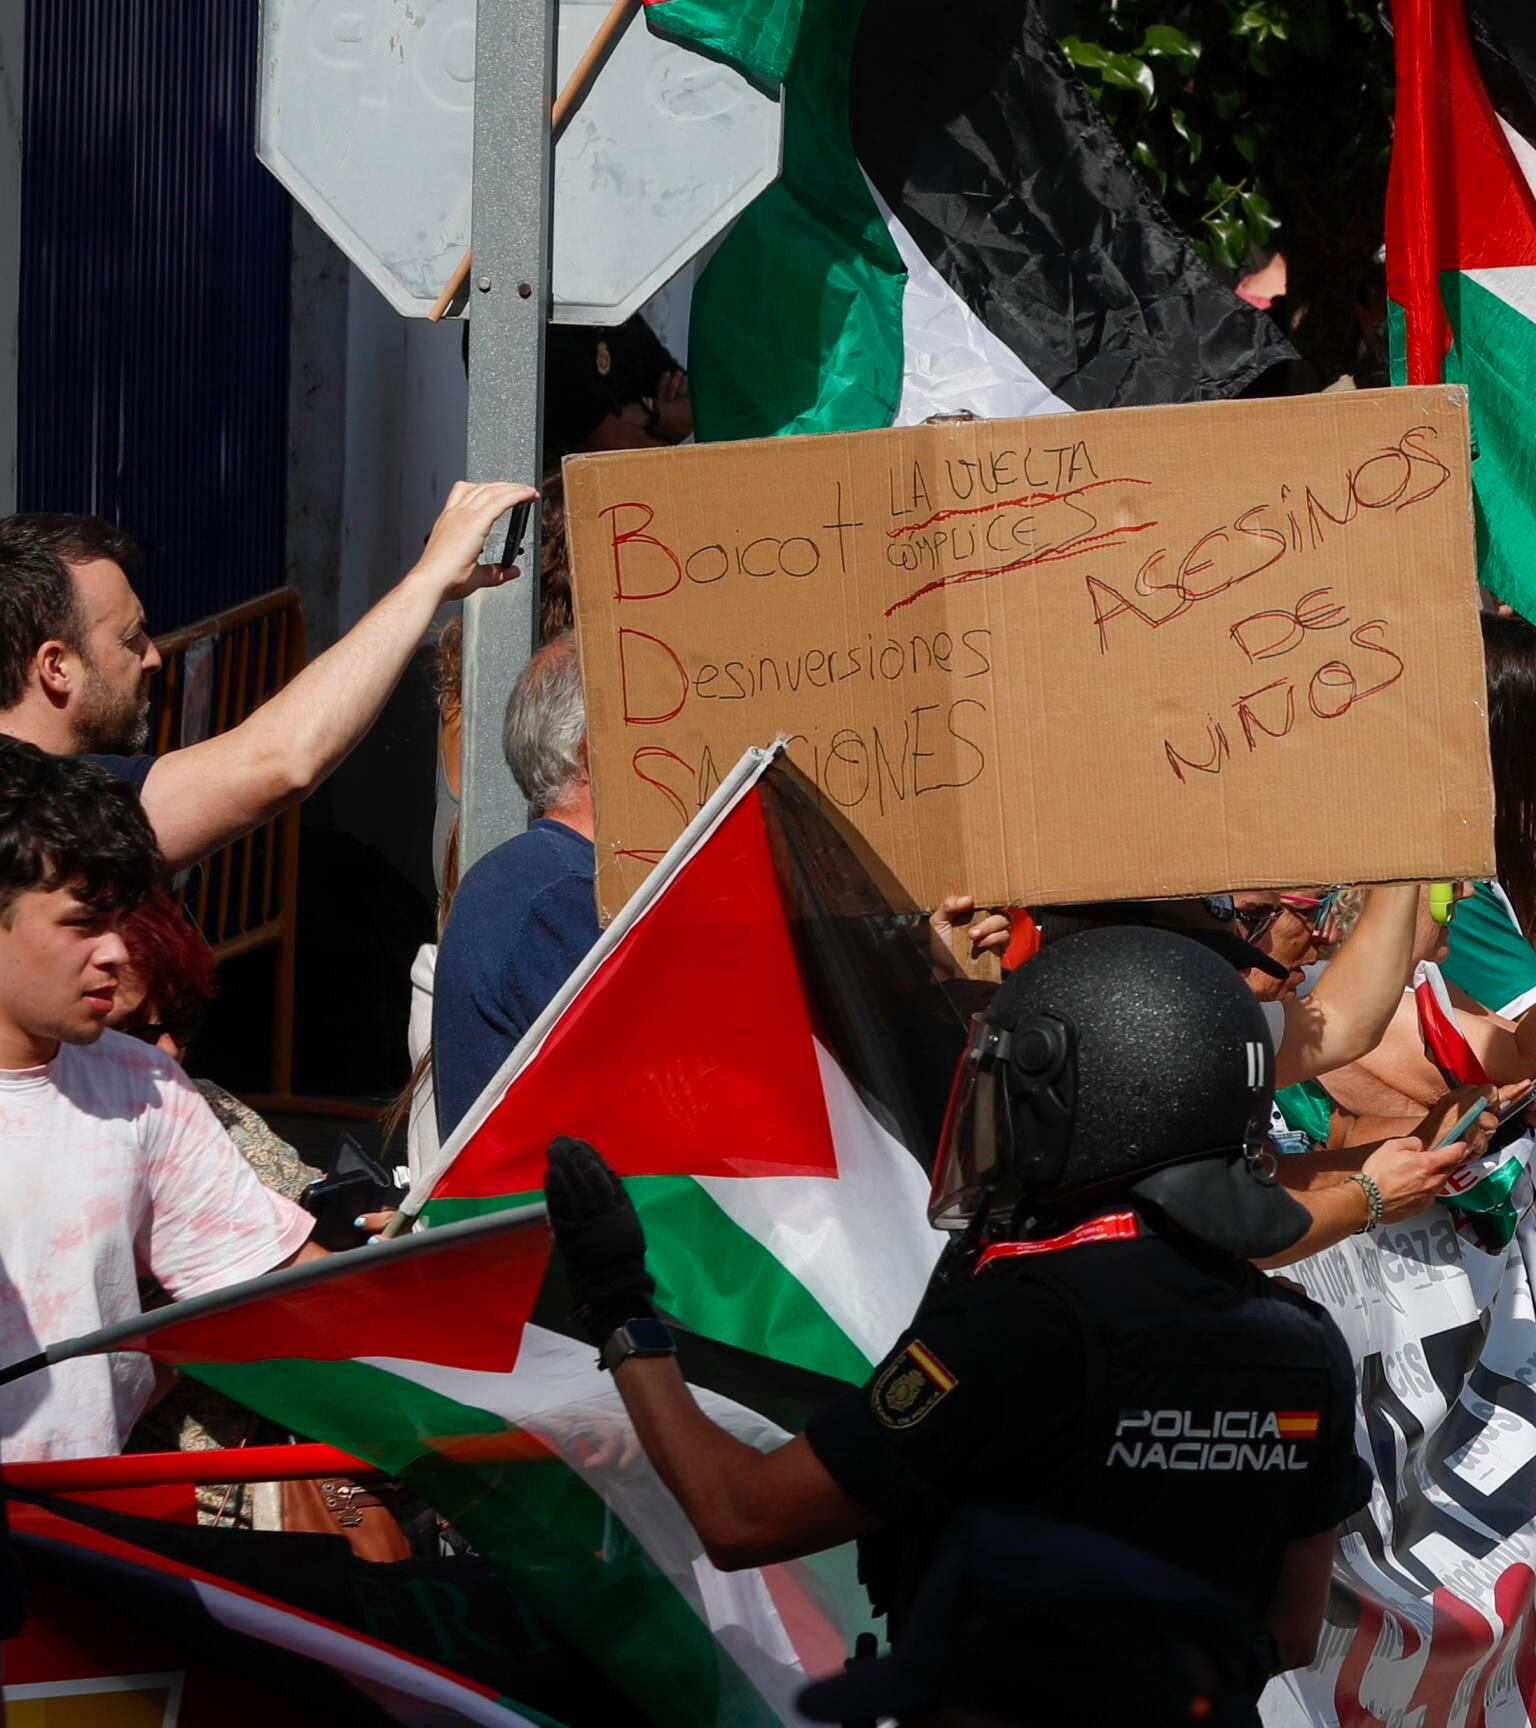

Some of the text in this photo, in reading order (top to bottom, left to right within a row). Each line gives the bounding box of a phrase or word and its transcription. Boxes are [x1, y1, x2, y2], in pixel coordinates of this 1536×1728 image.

[889, 440, 1099, 517] LA VUELTA
[1229, 586, 1350, 666] DE
[1106, 1441, 1310, 1472] NACIONAL
